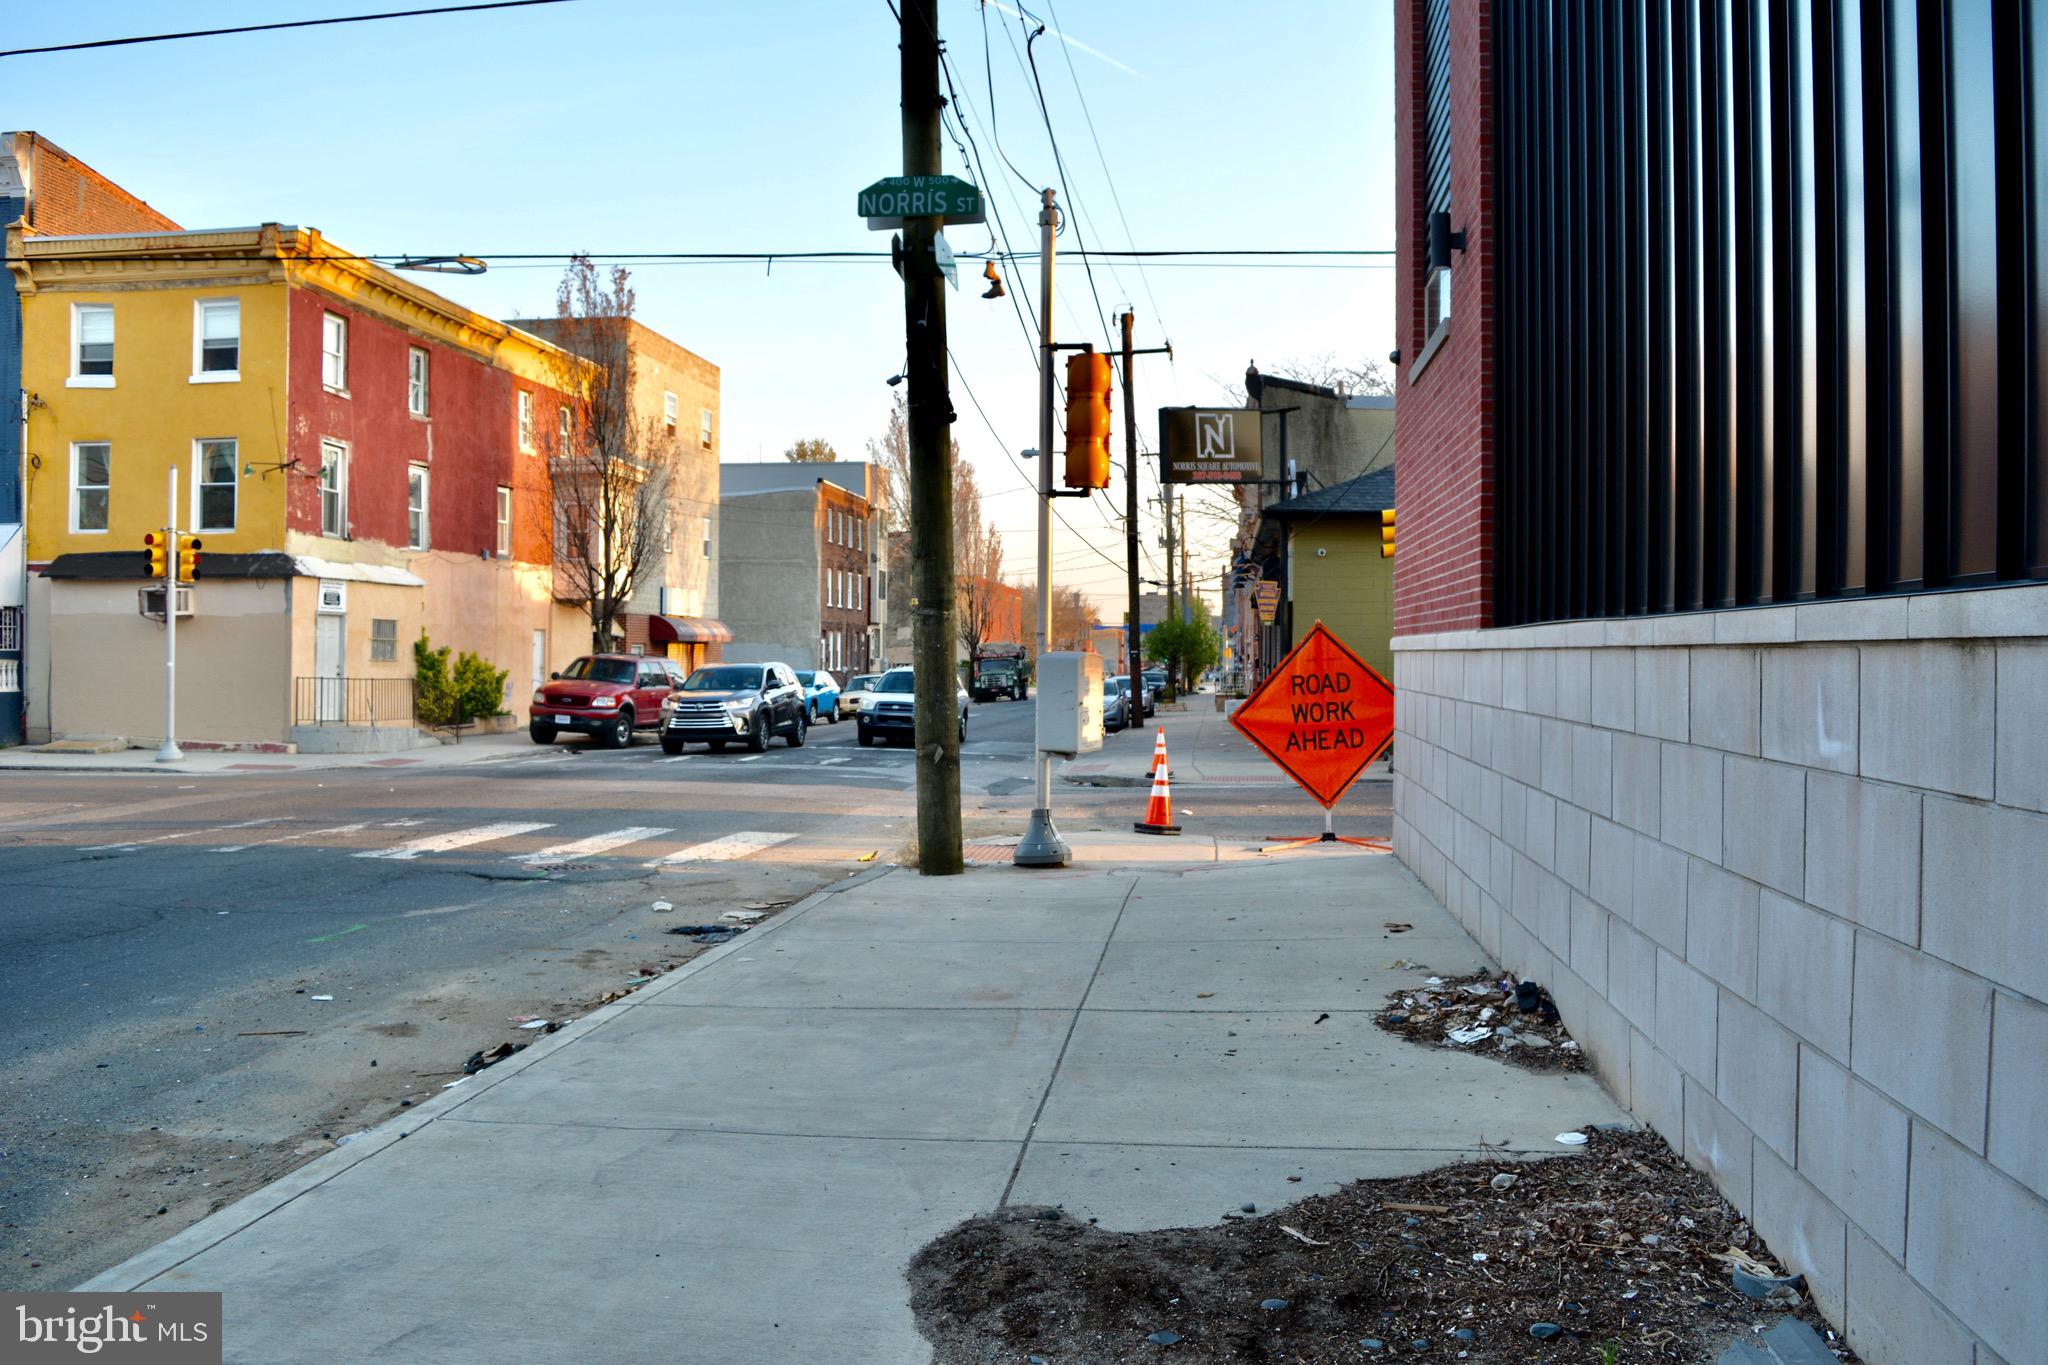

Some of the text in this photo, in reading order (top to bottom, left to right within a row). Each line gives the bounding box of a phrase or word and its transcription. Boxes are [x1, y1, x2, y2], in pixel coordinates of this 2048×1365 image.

[889, 175, 949, 187] 400 W 500
[861, 191, 975, 215] NORRIS ST
[1291, 673, 1351, 696] ROAD
[1291, 701, 1356, 724] WORK
[1285, 728, 1365, 752] AHEAD
